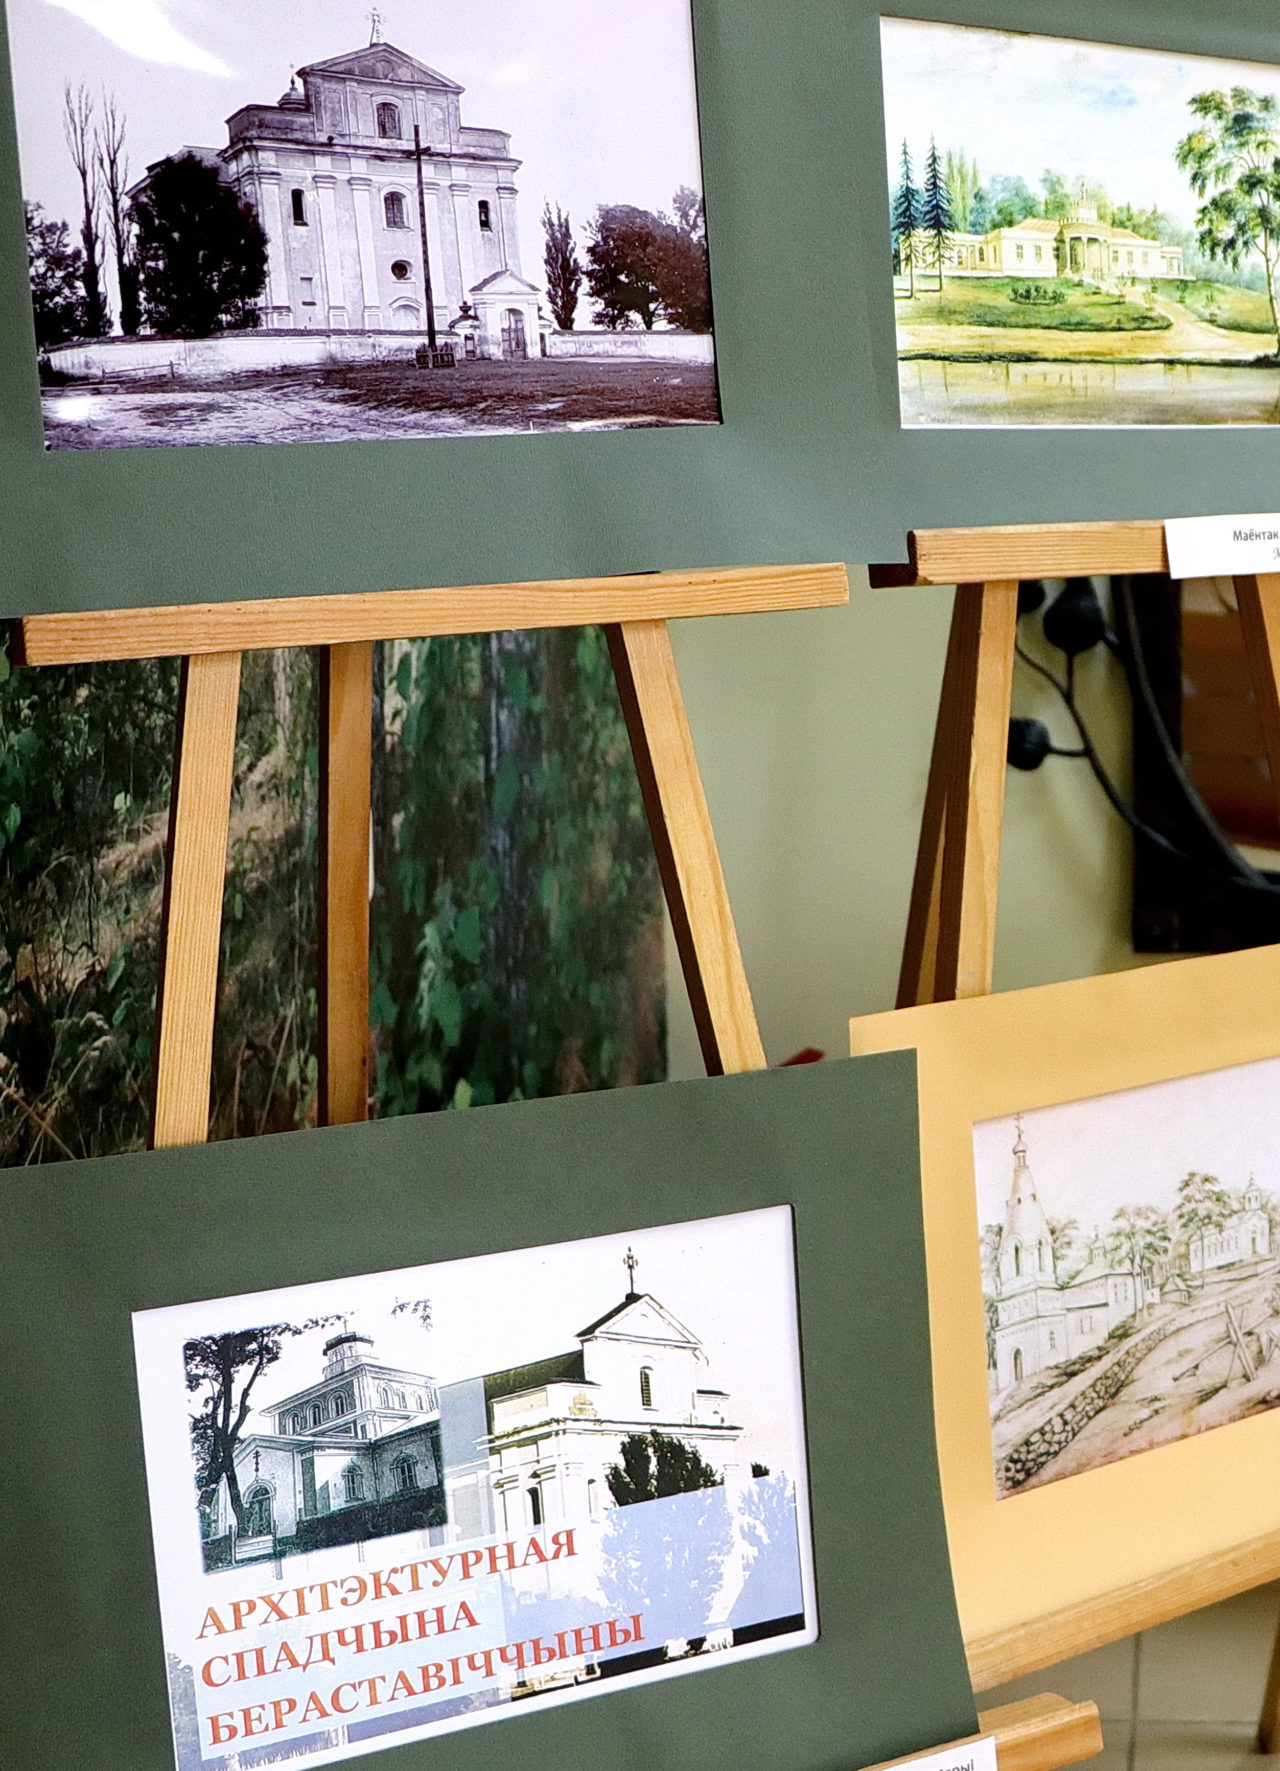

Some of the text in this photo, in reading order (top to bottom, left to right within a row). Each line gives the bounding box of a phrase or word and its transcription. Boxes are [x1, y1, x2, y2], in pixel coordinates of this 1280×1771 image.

[1233, 528, 1279, 542] Маёнтак
[195, 1528, 579, 1640] АРХІТЭКТУРНАЯ
[200, 1599, 481, 1690] СПАДЧЫНА
[206, 1612, 645, 1747] БЕРАСТАВІЧЧЫНЫ
